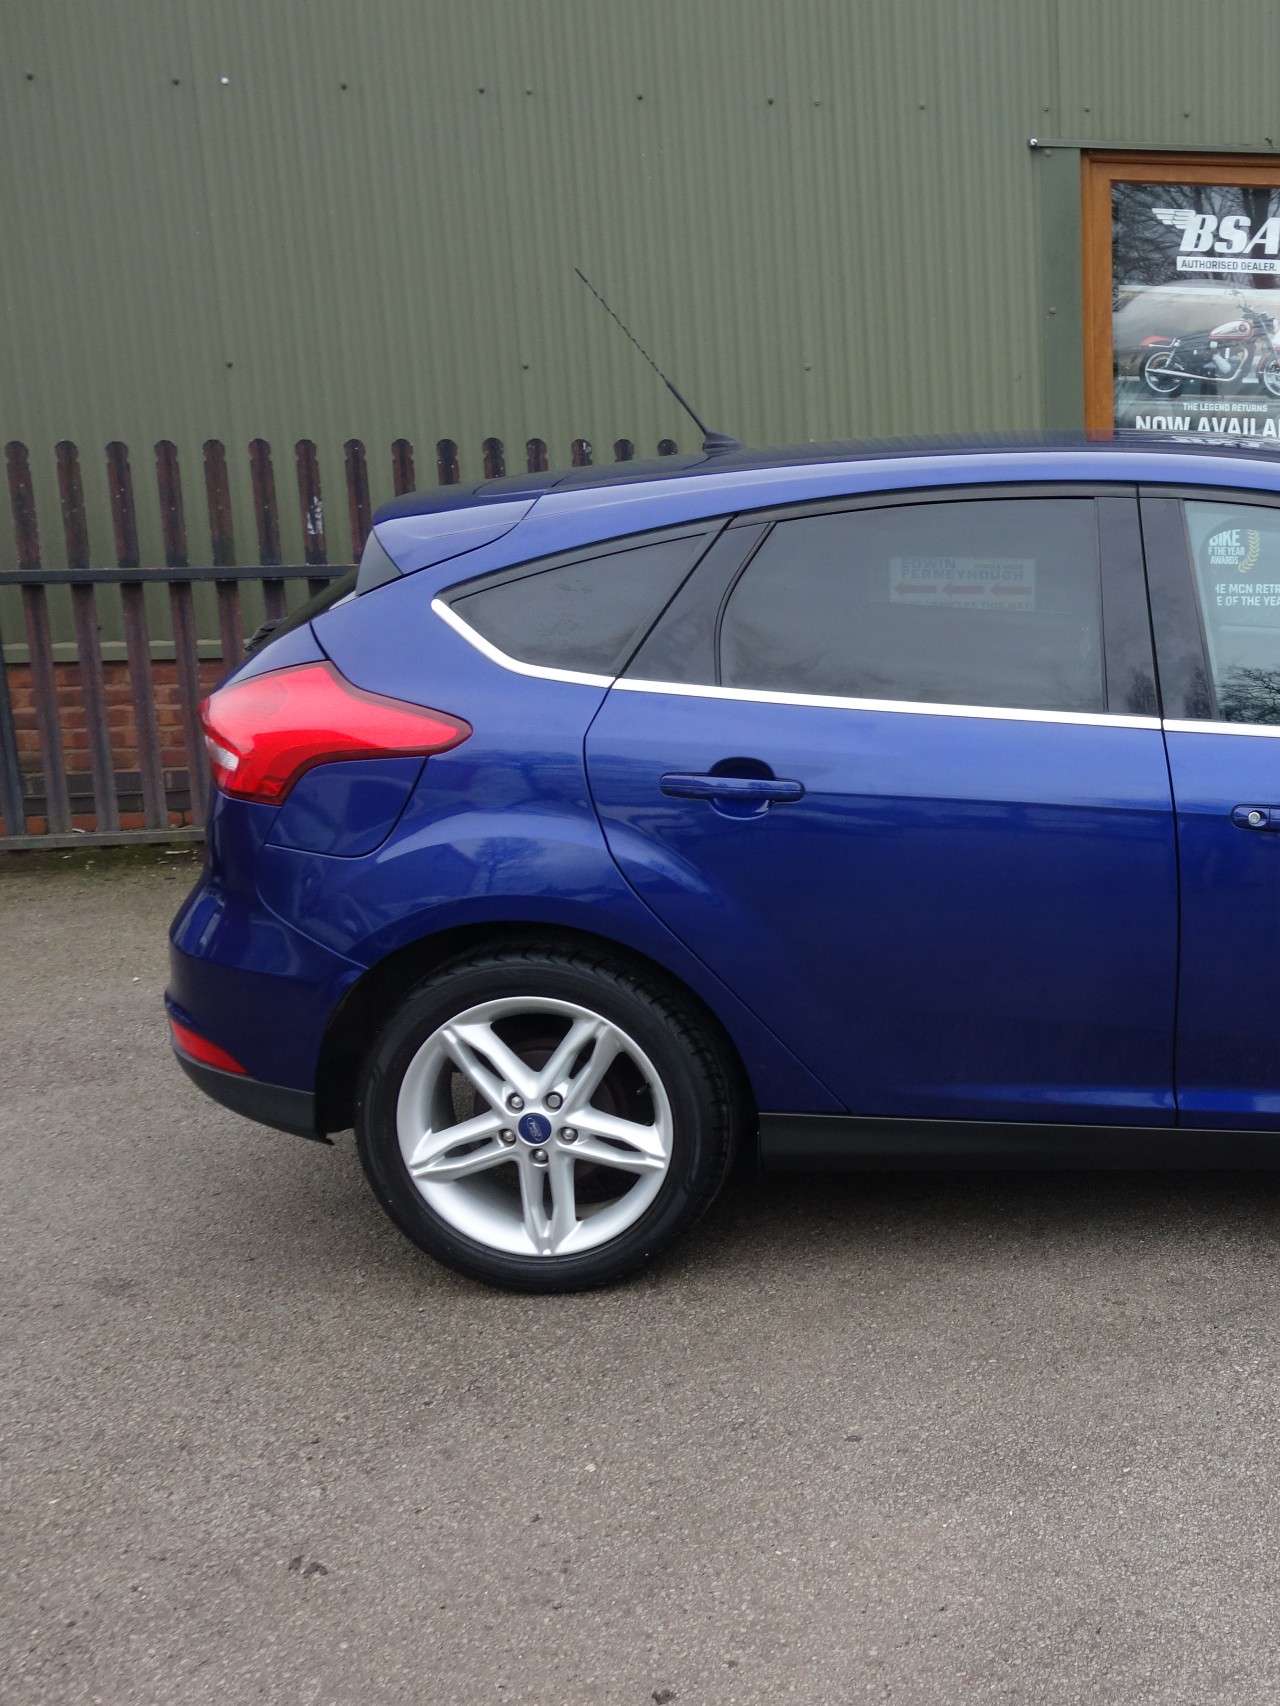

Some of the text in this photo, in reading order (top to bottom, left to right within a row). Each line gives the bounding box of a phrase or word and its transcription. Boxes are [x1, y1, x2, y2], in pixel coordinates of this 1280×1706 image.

[1176, 214, 1280, 255] BSA
[1181, 259, 1239, 271] AUTHORISED
[1183, 402, 1268, 413] THE LEGEND RETURNS
[1135, 415, 1191, 431] NOW
[1229, 584, 1252, 594] MCN
[1225, 596, 1238, 606] OF
[1241, 596, 1261, 606] THE
